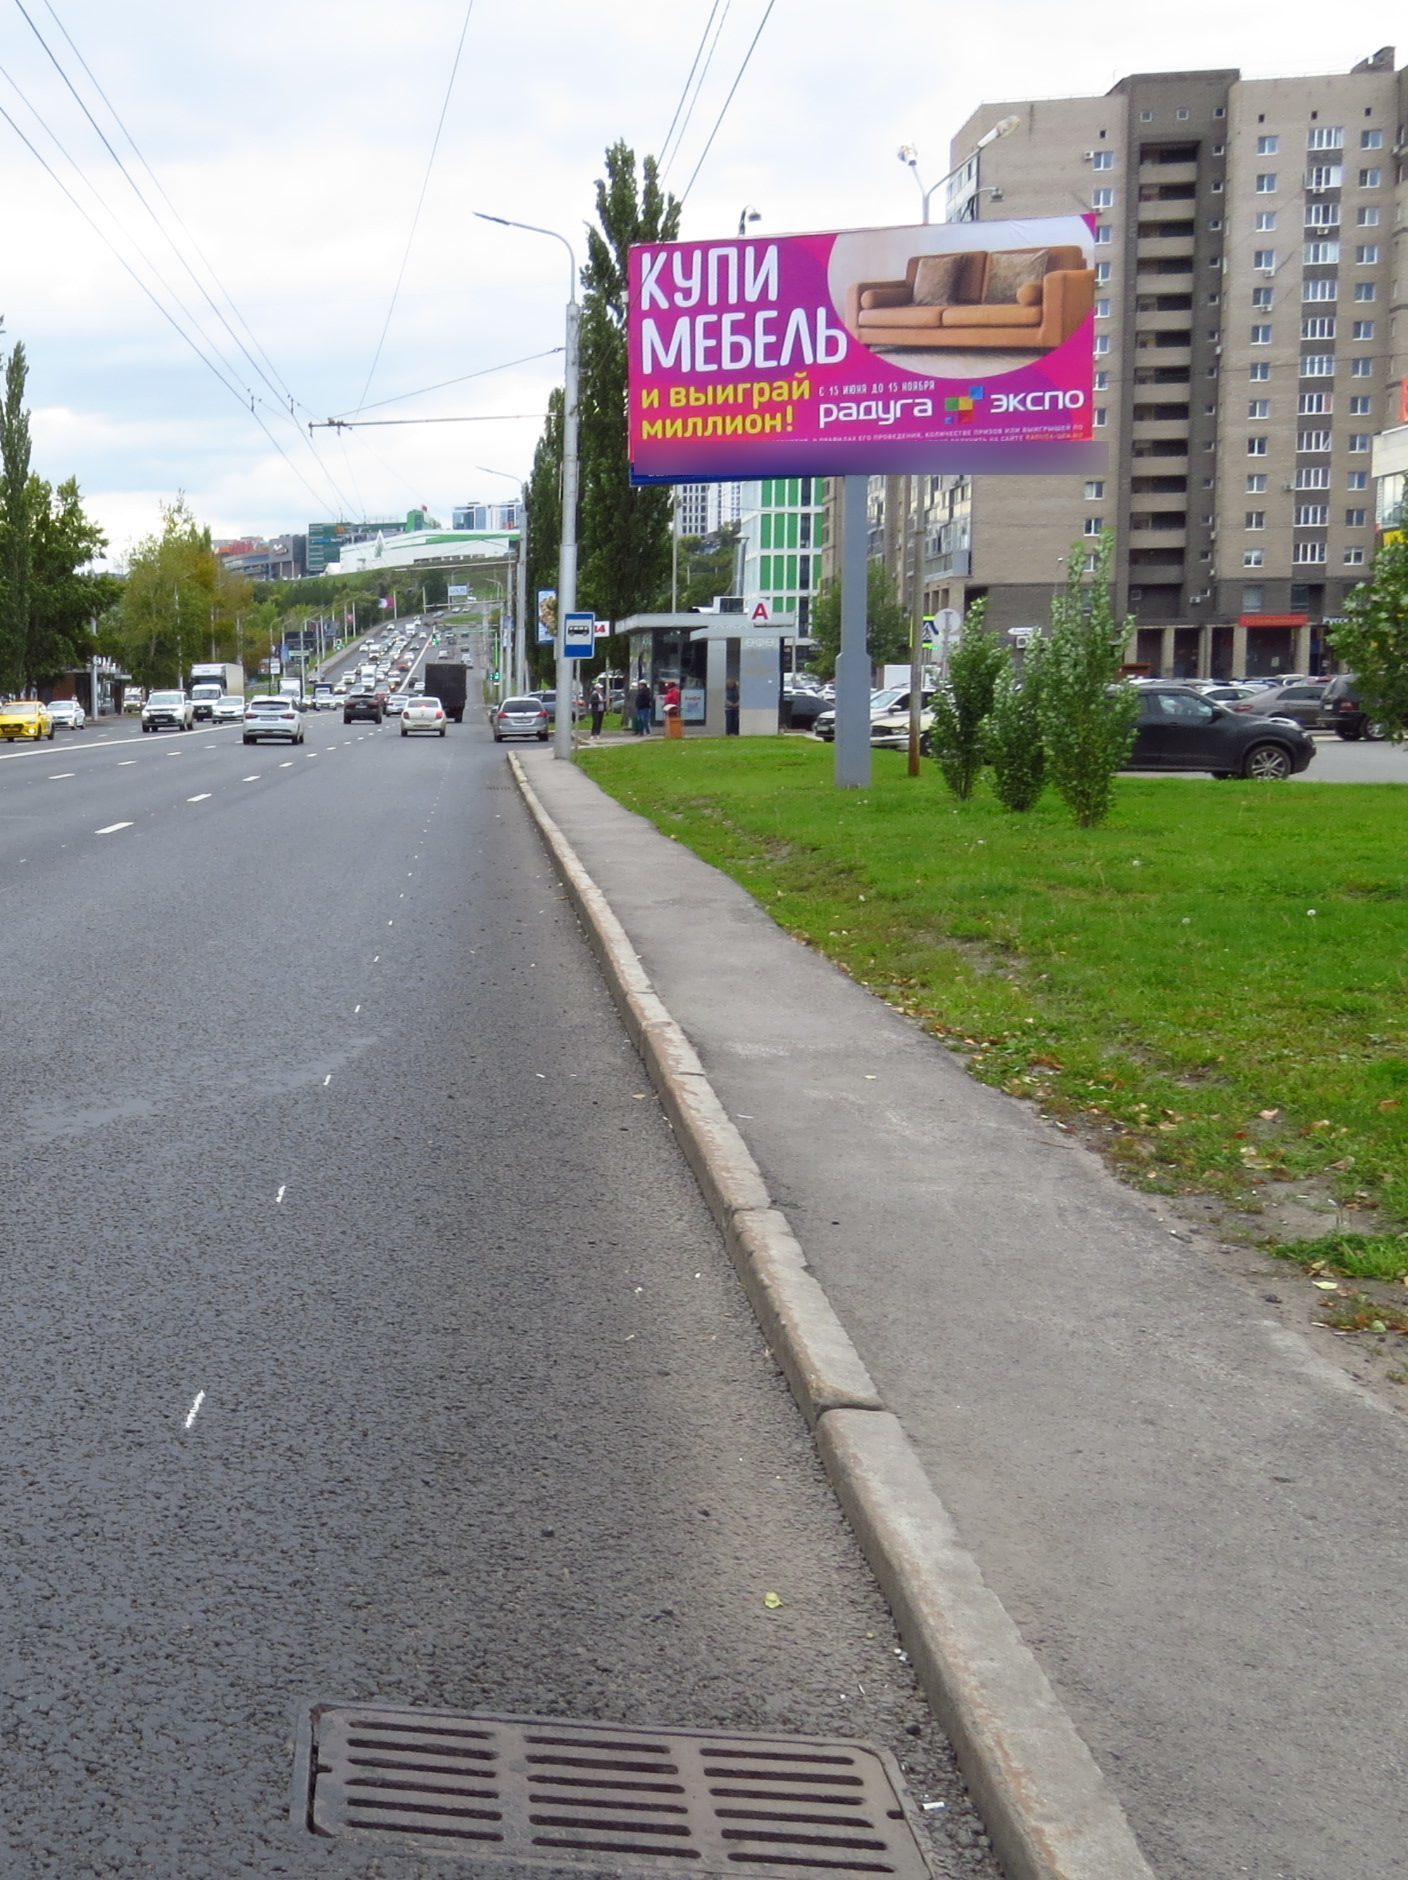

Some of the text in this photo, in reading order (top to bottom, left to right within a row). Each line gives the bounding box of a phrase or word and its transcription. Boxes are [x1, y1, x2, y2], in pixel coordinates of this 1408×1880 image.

[641, 244, 778, 311] КУПИ
[642, 306, 848, 375] МЕБЕЛЬ
[642, 371, 811, 410] и выиграй
[829, 385, 839, 396] 15
[843, 383, 867, 395] ИЮНЯ
[871, 383, 884, 394] ДО
[888, 382, 898, 393] 15
[902, 380, 935, 391] НОЯБРЯ
[642, 405, 793, 440] миллион!
[819, 398, 933, 429] радуга
